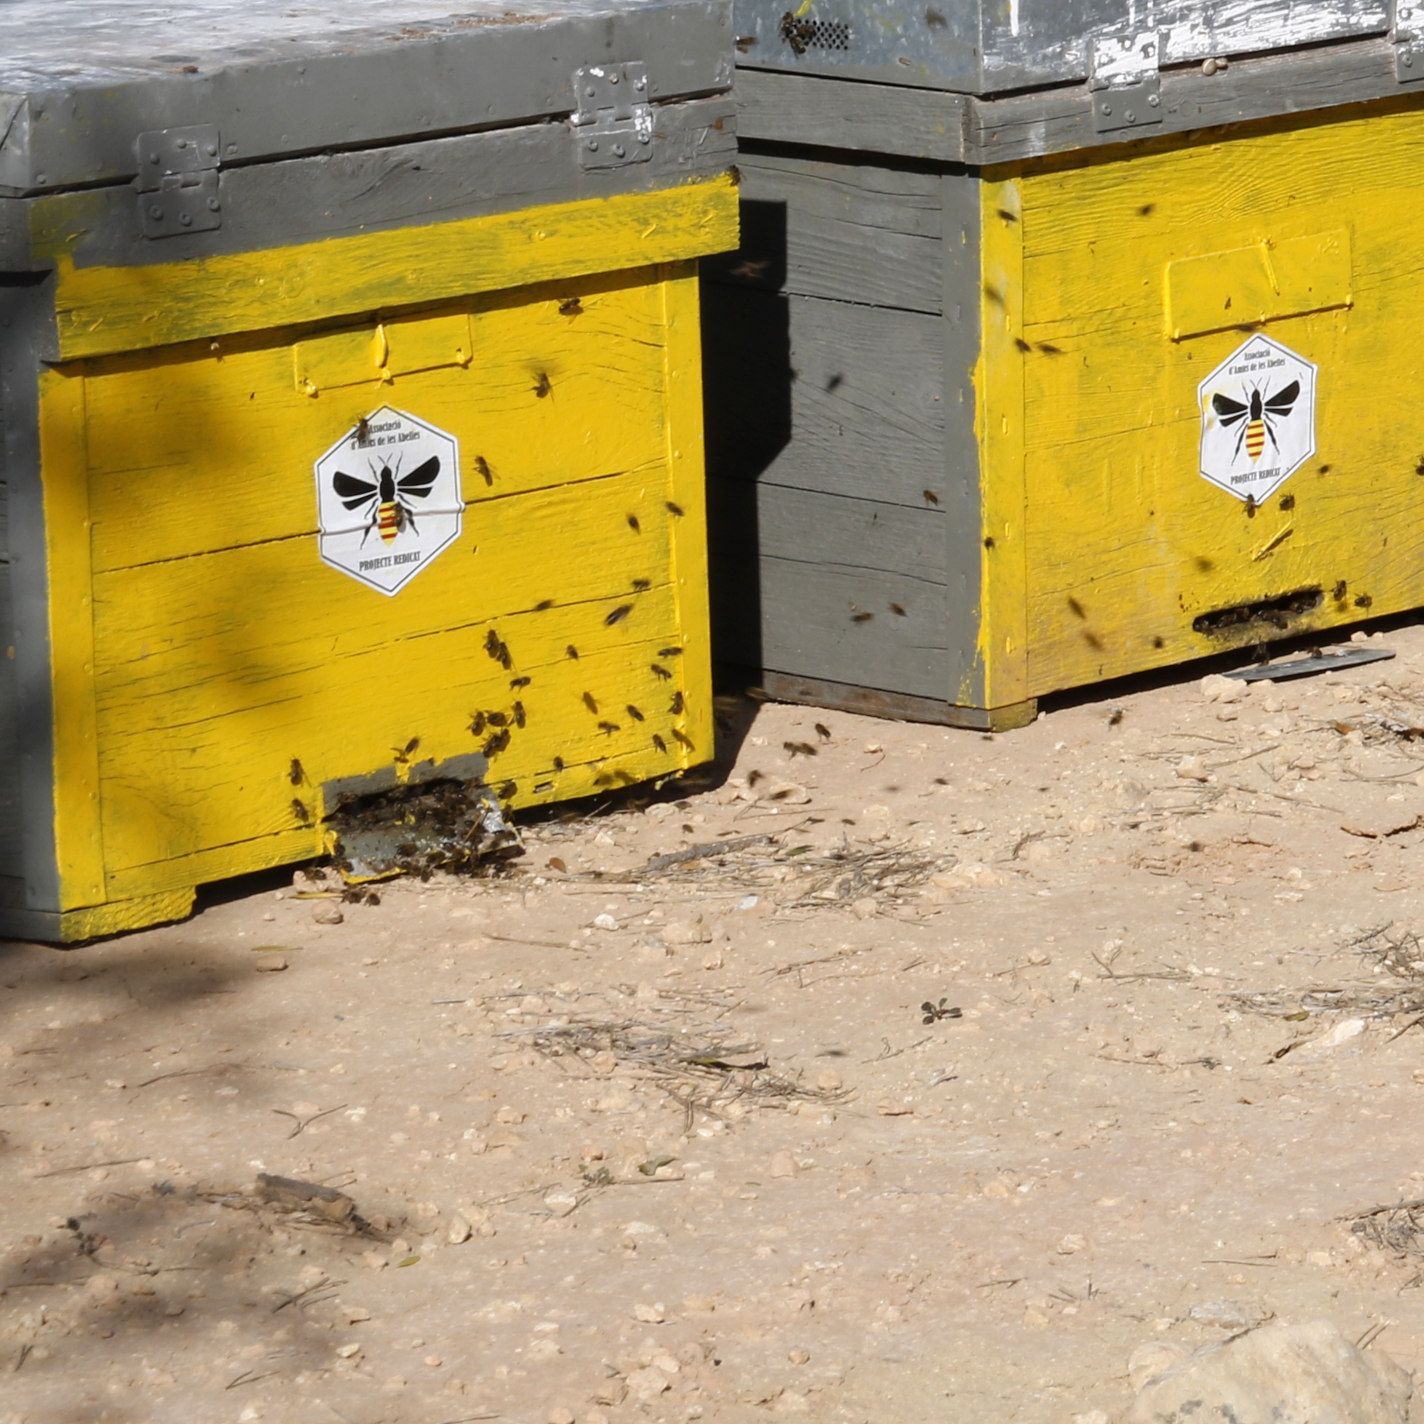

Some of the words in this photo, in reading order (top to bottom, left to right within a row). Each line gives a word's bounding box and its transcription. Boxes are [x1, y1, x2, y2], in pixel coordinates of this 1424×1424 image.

[1250, 363, 1257, 371] de
[1258, 361, 1266, 370] les
[377, 436, 386, 446] de
[387, 435, 396, 445] les
[398, 431, 421, 443] Abelles
[1230, 471, 1257, 485] PROJECTE
[1258, 467, 1281, 480] REDICAT
[359, 556, 392, 572] PROJECTE
[393, 551, 421, 565] REDICAT
